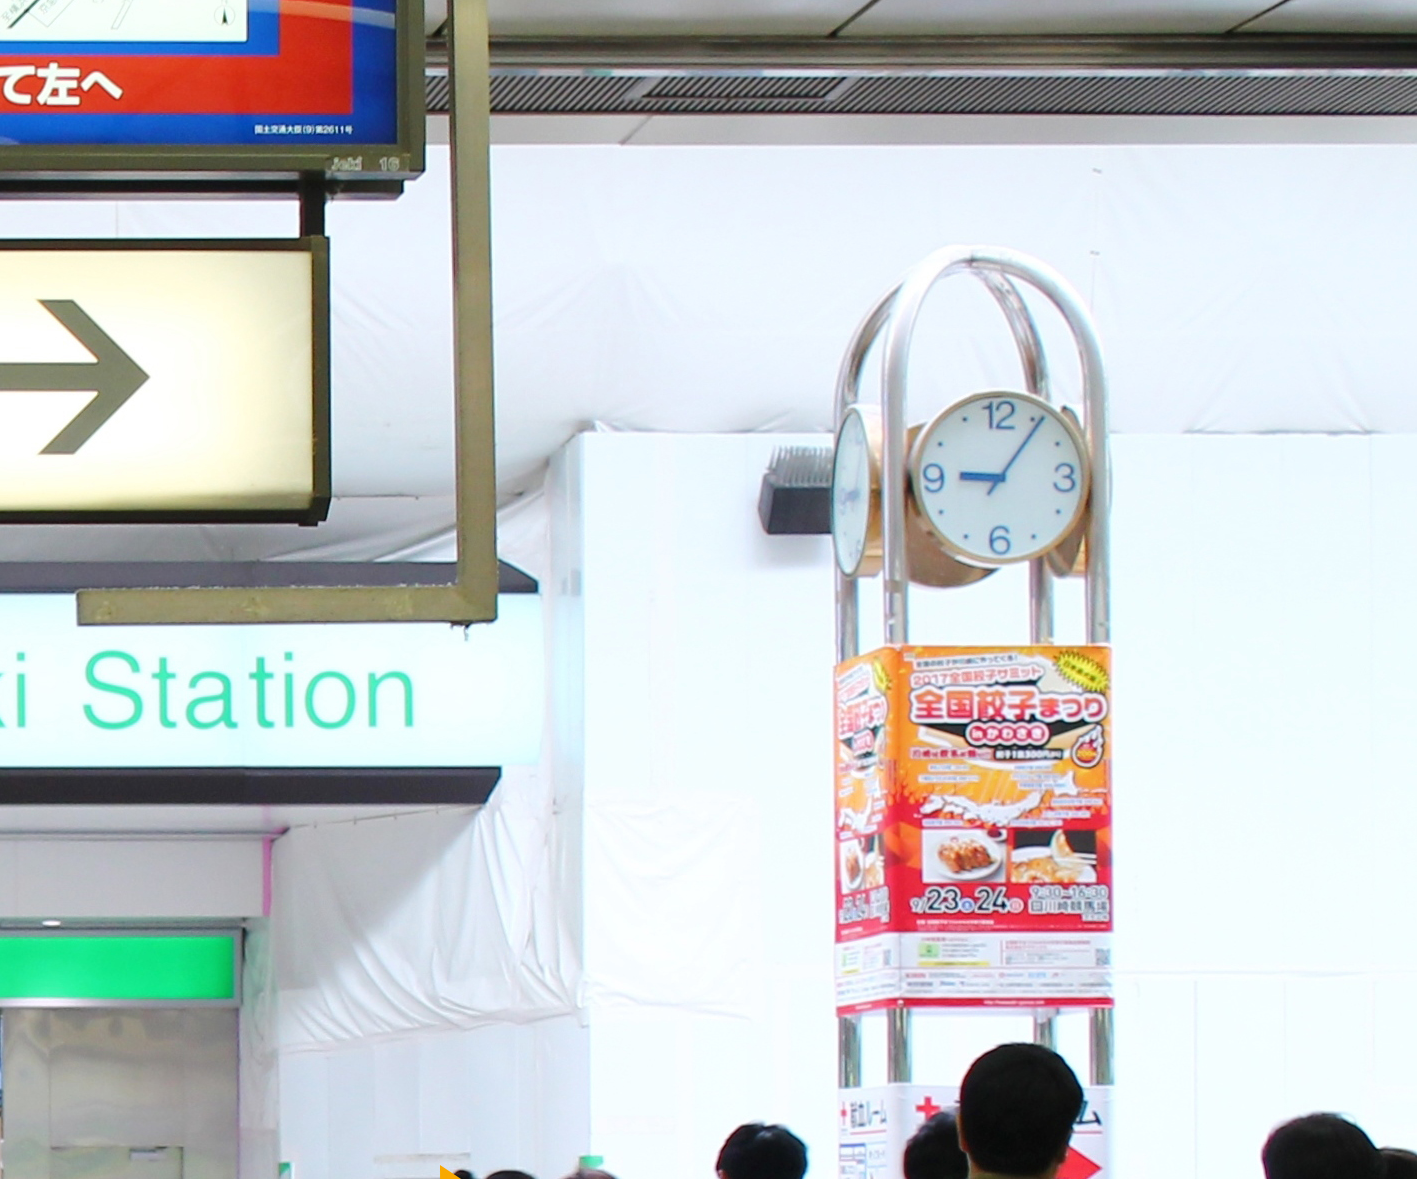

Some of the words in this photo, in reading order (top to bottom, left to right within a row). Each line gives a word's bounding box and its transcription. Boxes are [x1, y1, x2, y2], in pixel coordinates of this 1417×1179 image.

[982, 401, 1016, 430] 12
[923, 464, 945, 493] 9
[1053, 464, 1076, 493] 3
[989, 526, 1011, 555] 6
[80, 648, 416, 732] Station
[913, 688, 1105, 721] 全国餃子まつり
